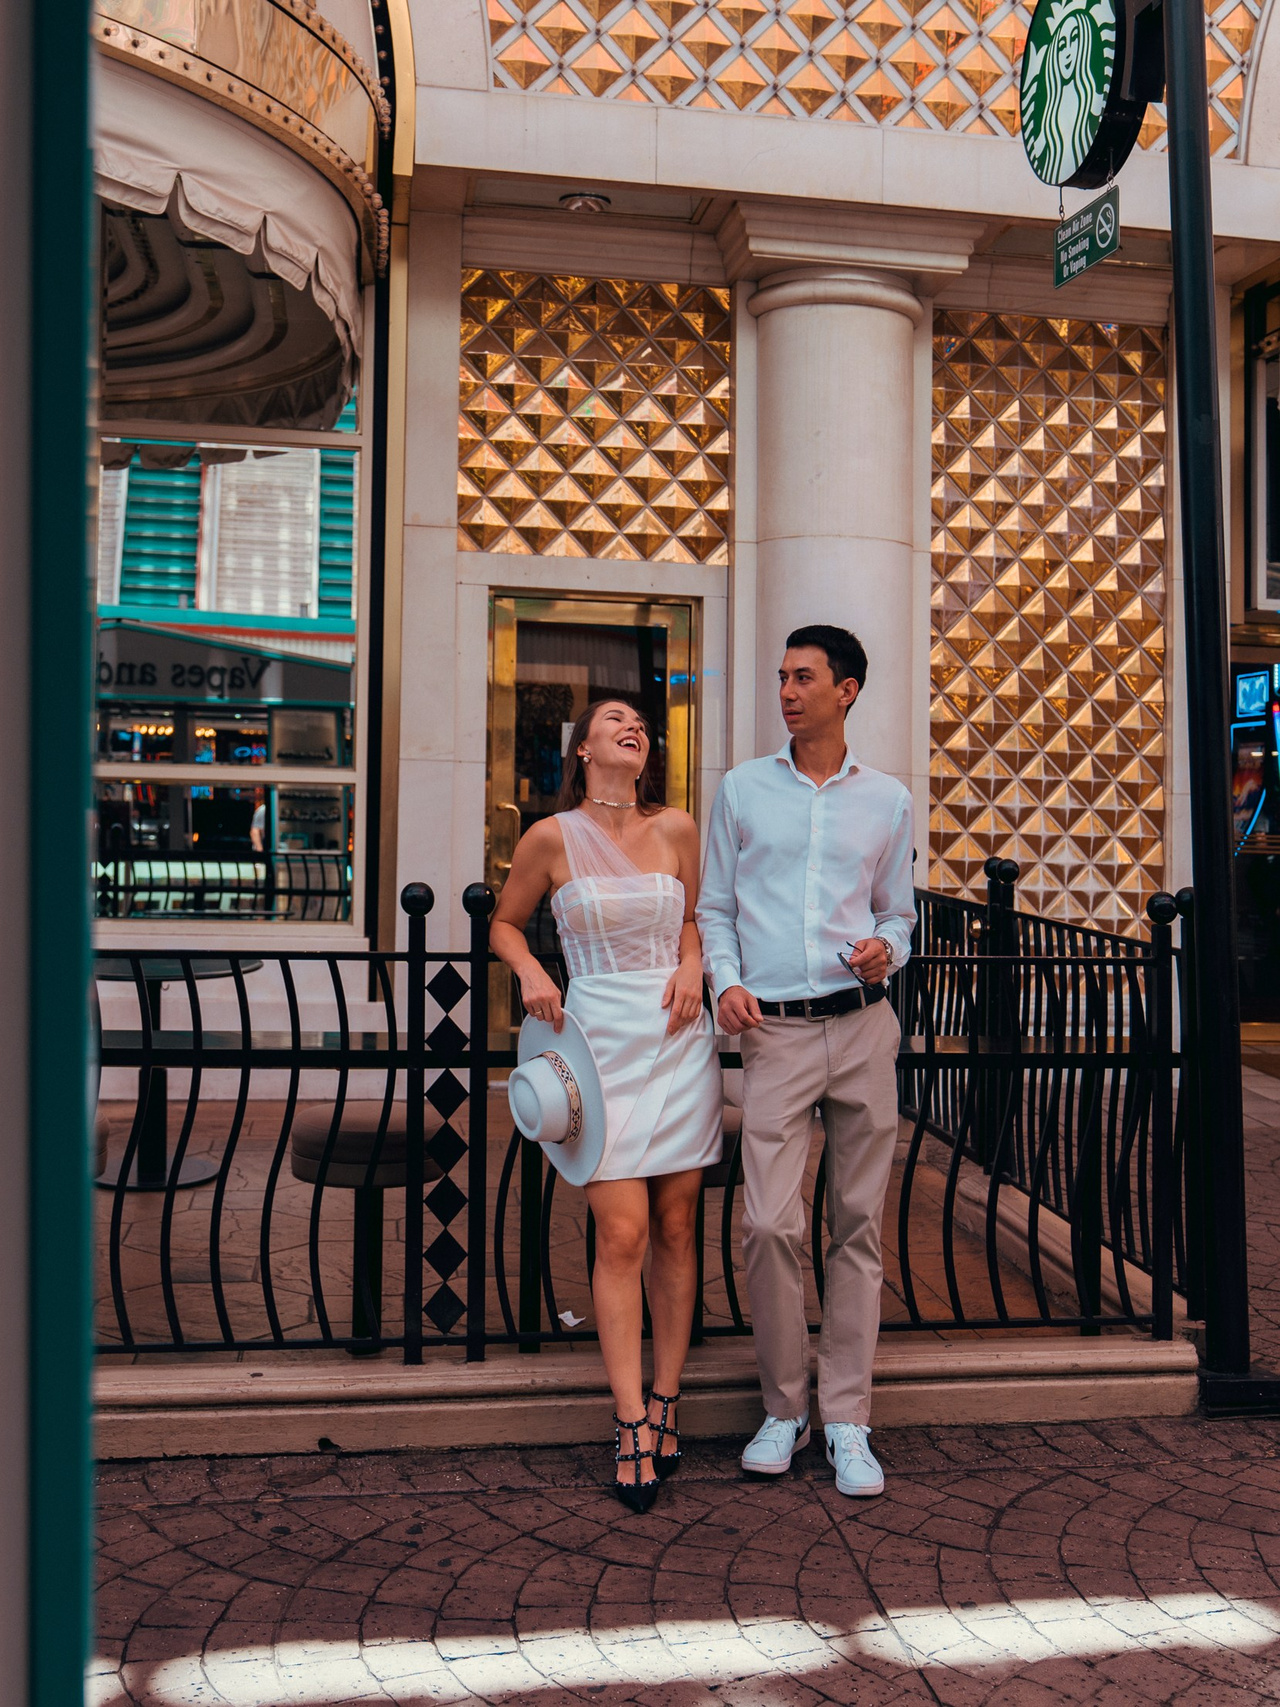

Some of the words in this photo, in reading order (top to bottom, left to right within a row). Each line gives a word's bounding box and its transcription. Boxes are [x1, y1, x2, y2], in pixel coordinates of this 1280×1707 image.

[1058, 226, 1072, 243] Clean
[1072, 219, 1080, 233] Air
[1080, 212, 1093, 228] Zone
[1060, 250, 1068, 264] No
[1068, 237, 1089, 259] Smoking
[1063, 264, 1069, 278] Or
[1069, 255, 1086, 273] Vaping
